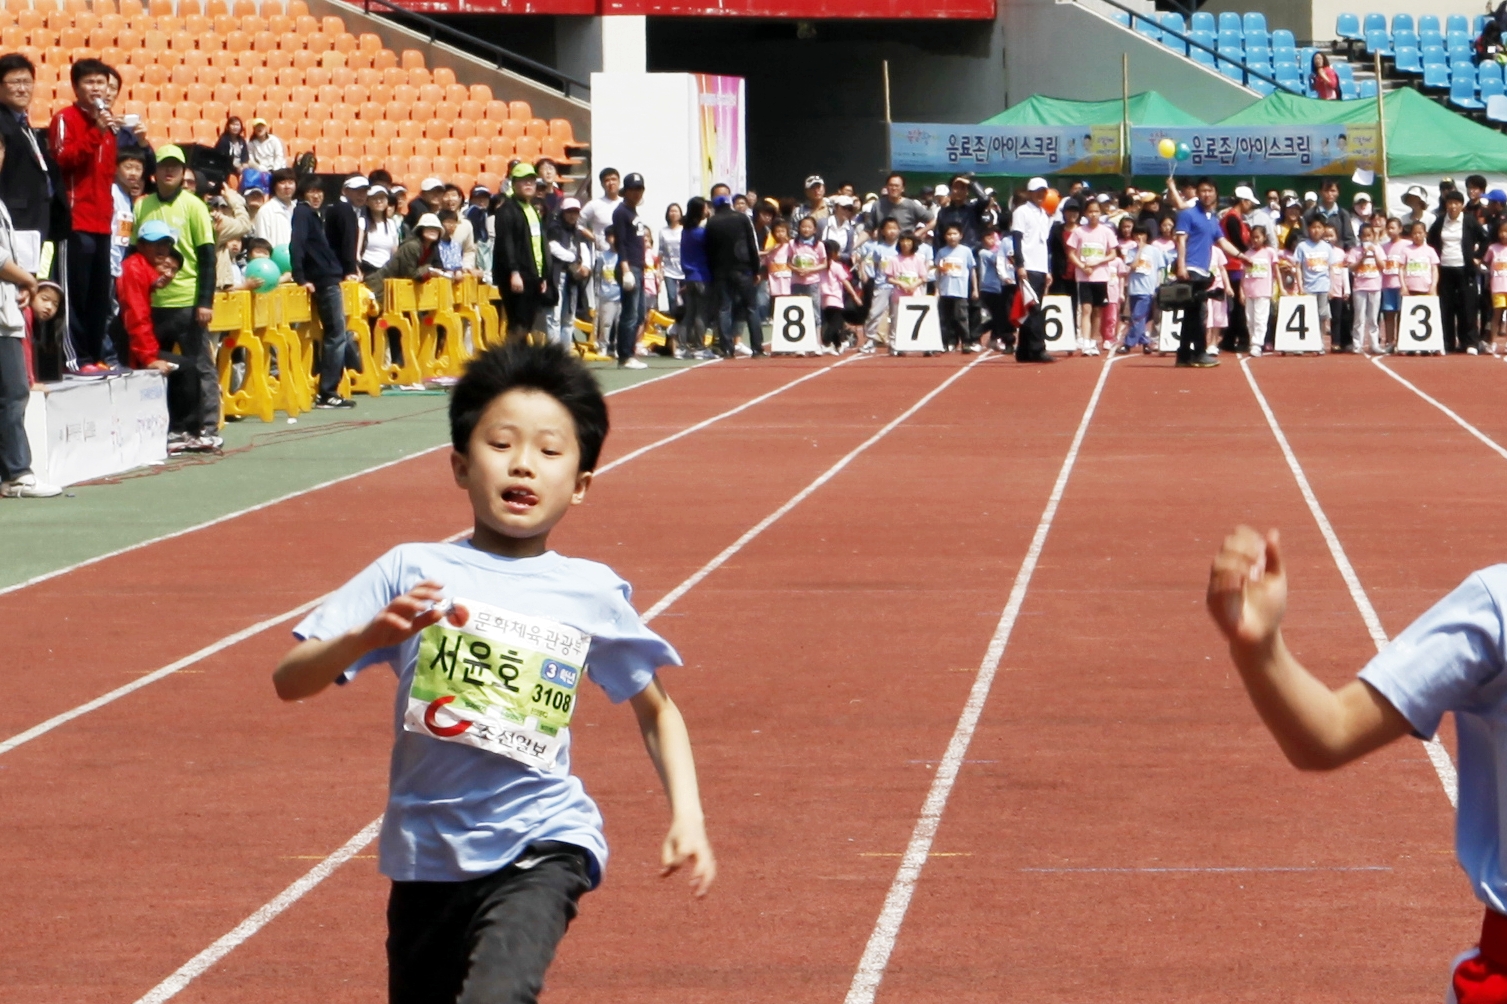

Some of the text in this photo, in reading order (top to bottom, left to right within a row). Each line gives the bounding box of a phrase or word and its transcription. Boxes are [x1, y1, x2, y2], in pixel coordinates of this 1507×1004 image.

[945, 133, 1060, 164] 음료존/아이스크림
[1190, 135, 1312, 165] 음료존/아이스크림
[782, 304, 806, 342] 8
[906, 304, 930, 341] 7
[1041, 304, 1063, 341] 6
[1285, 303, 1309, 340] 4
[1409, 304, 1432, 341] 3
[473, 610, 583, 657] 문화체육관광부
[429, 634, 524, 693] 서윤호
[545, 663, 558, 679] 3
[532, 683, 572, 713] 3108
[479, 723, 548, 761] 조선일보
